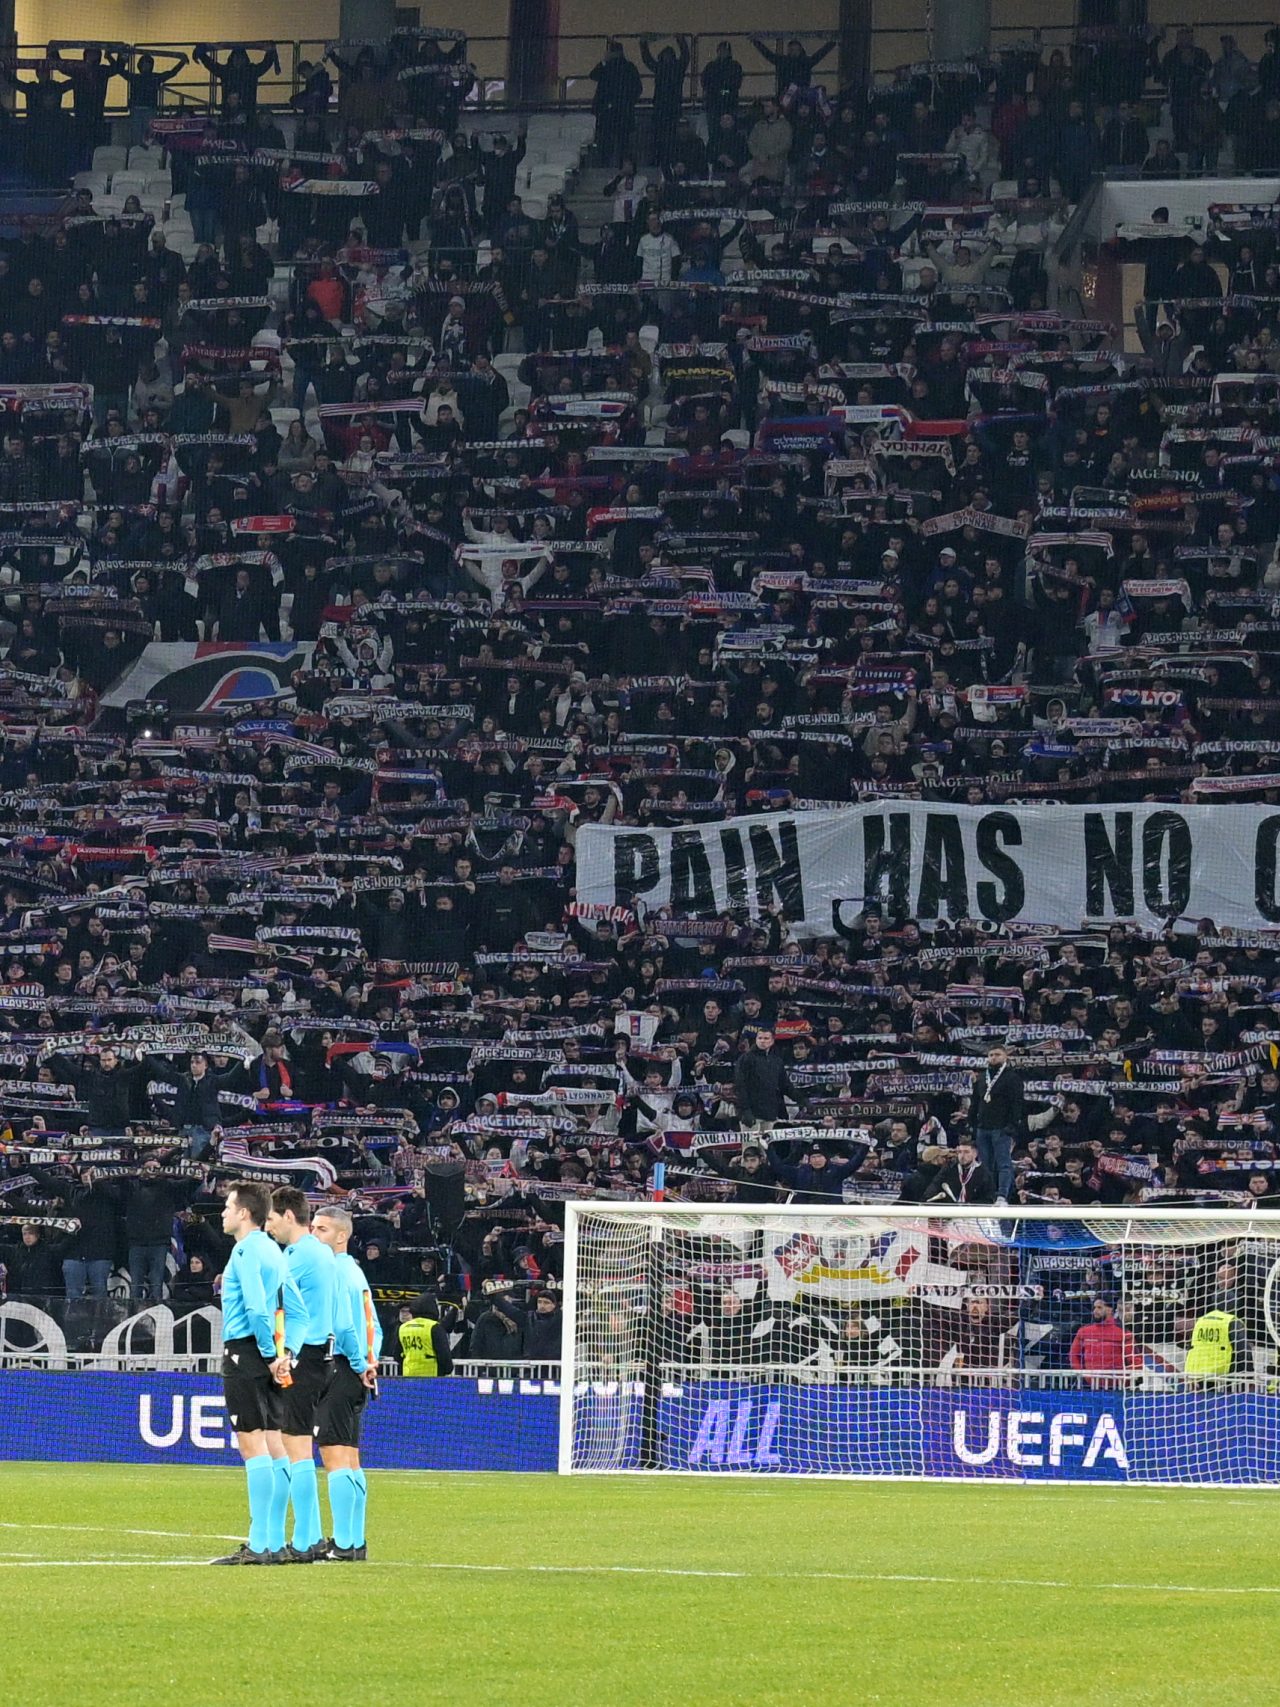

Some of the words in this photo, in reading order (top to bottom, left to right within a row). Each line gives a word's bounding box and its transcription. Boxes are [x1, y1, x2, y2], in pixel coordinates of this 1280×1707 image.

[88, 315, 142, 326] LYON
[614, 818, 806, 920] PAIN
[862, 810, 1026, 922] HAS
[1085, 809, 1193, 918] NO
[44, 1034, 86, 1050] BAD
[919, 1052, 958, 1065] VIRAGE
[568, 1090, 612, 1101] LYONNAIS
[72, 1135, 103, 1147] BAD
[133, 1135, 183, 1147] GONES
[29, 1152, 55, 1164] BAD
[81, 1149, 122, 1163] GONES
[241, 1170, 292, 1183] GONES
[379, 1287, 426, 1300] 195
[917, 1284, 960, 1300] BAD
[971, 1284, 1038, 1300] GONES
[139, 1394, 241, 1449] UE
[689, 1398, 782, 1465] ALL
[953, 1408, 1131, 1470] UEFA
